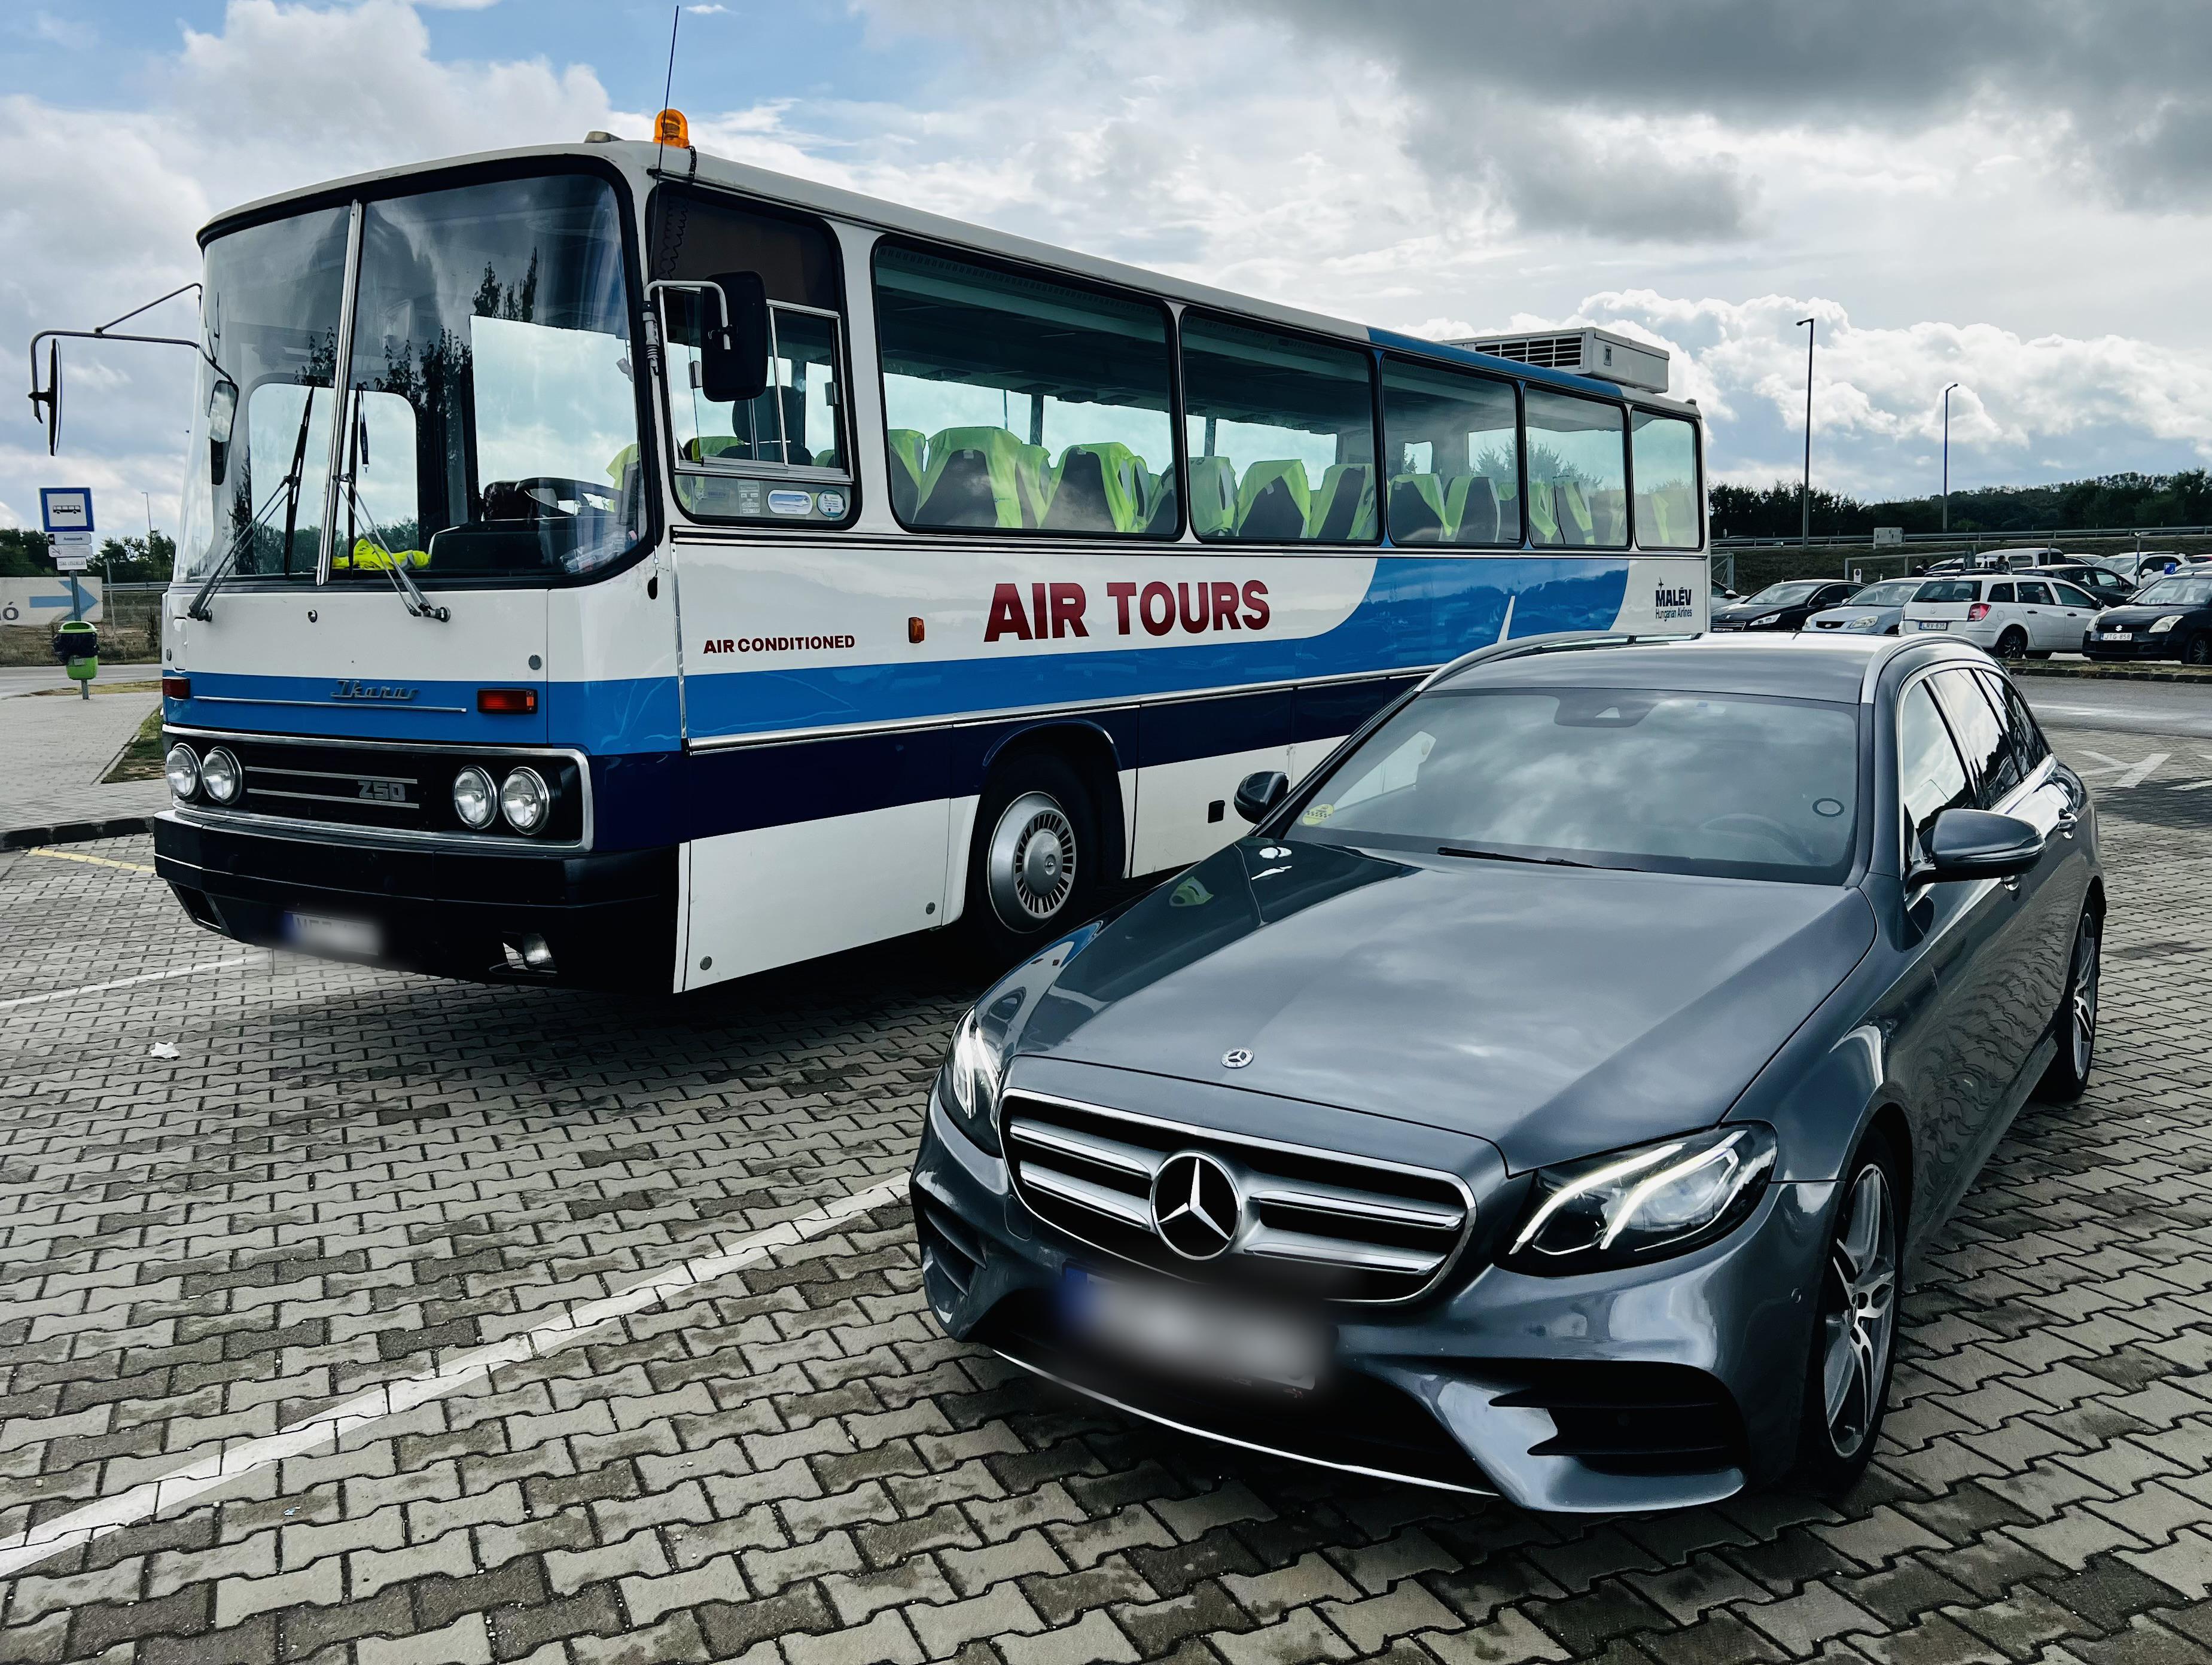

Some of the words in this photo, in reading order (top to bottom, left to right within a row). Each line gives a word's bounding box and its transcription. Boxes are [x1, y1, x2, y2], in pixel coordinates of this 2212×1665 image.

[1655, 587, 1692, 607] MALÉV
[984, 583, 1089, 642] AIR
[1107, 580, 1269, 636] TOURS
[1655, 608, 1676, 622] Hungarian
[1677, 606, 1692, 618] Airlines
[703, 639, 735, 654] AIR
[738, 635, 855, 652] CONDITIONED
